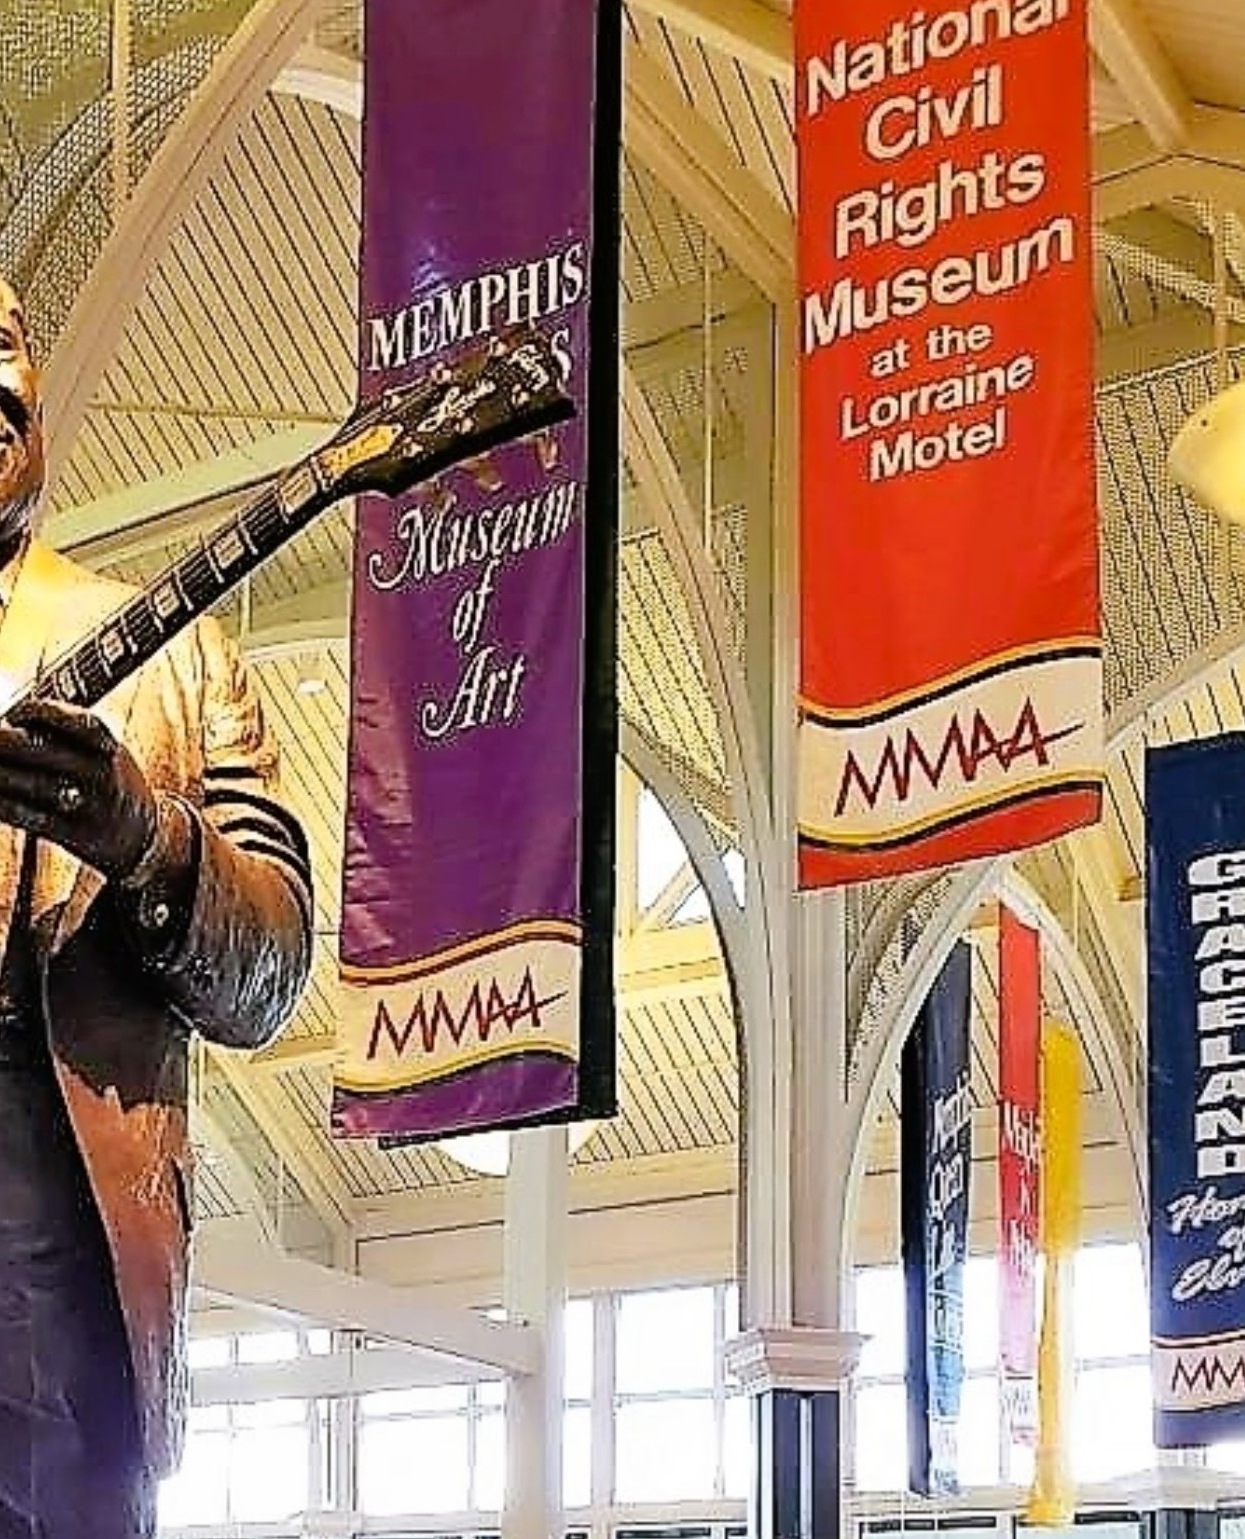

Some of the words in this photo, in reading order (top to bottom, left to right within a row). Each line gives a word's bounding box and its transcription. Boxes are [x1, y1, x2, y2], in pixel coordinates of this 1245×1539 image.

[866, 64, 1002, 160] Civil
[835, 152, 1046, 259] Rights
[367, 242, 584, 372] MEMPHIS
[805, 218, 1075, 355] Museum
[841, 354, 1035, 439] Lorraine
[870, 338, 910, 377] at
[926, 323, 993, 360] the
[869, 406, 1006, 481] Motel
[368, 481, 577, 589] Museum
[453, 559, 501, 653] of
[421, 647, 526, 737] Art
